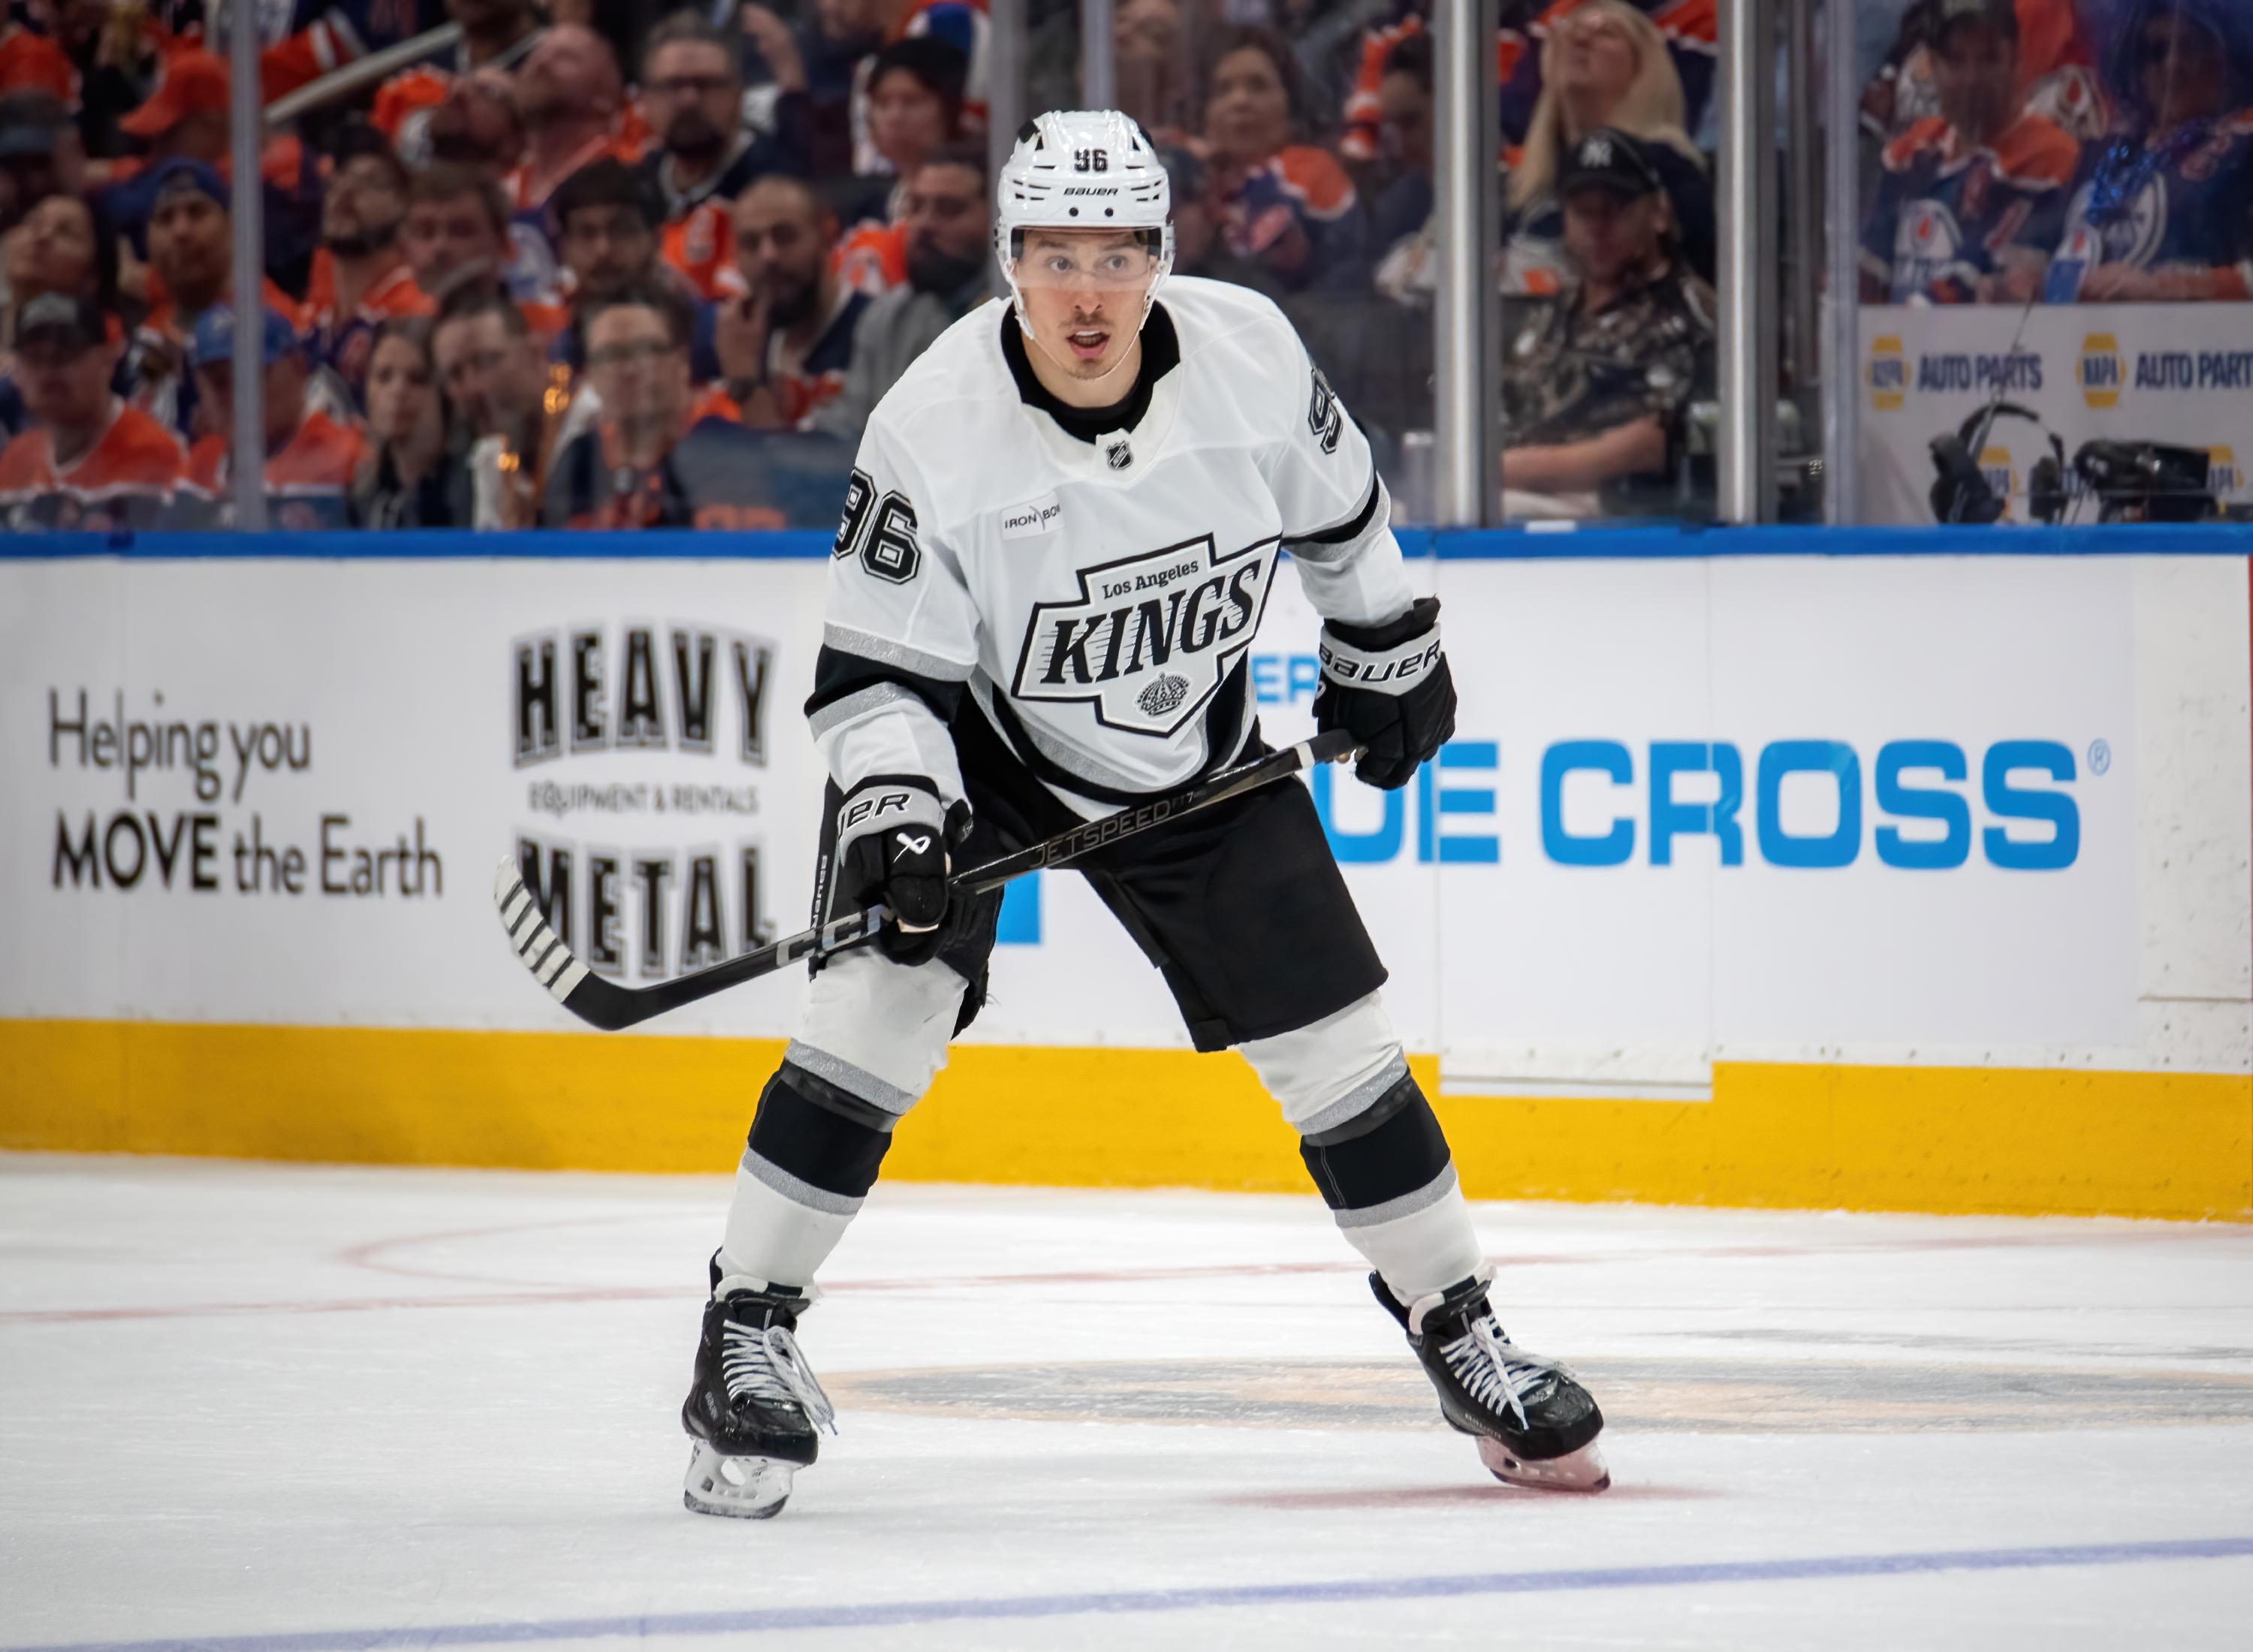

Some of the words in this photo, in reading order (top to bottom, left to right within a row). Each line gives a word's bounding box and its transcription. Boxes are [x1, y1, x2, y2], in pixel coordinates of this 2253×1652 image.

[1063, 187, 1119, 196] BAUER
[1073, 148, 1108, 173] 96
[1916, 354, 1972, 392] AUTO
[1975, 351, 2043, 390] PARTS
[2134, 351, 2194, 390] AUTO
[2197, 350, 2253, 390] PART
[1307, 368, 1344, 455] 9
[832, 466, 921, 585] 96
[1004, 512, 1037, 529] IRON
[1102, 580, 1132, 600] Los
[1135, 560, 1199, 591] Angeles
[1039, 558, 1262, 684] KINGS
[512, 621, 780, 768] HEAVY
[1319, 638, 1441, 683] BAUER
[49, 686, 223, 803] Helping
[229, 722, 312, 805] you
[1030, 799, 1171, 869] JETSPEED
[1311, 740, 1501, 866] UE
[1540, 739, 2081, 871] CROSS
[50, 809, 222, 892] MOVE
[232, 812, 308, 894] the
[318, 813, 444, 897] Earth
[516, 832, 777, 977] METAL
